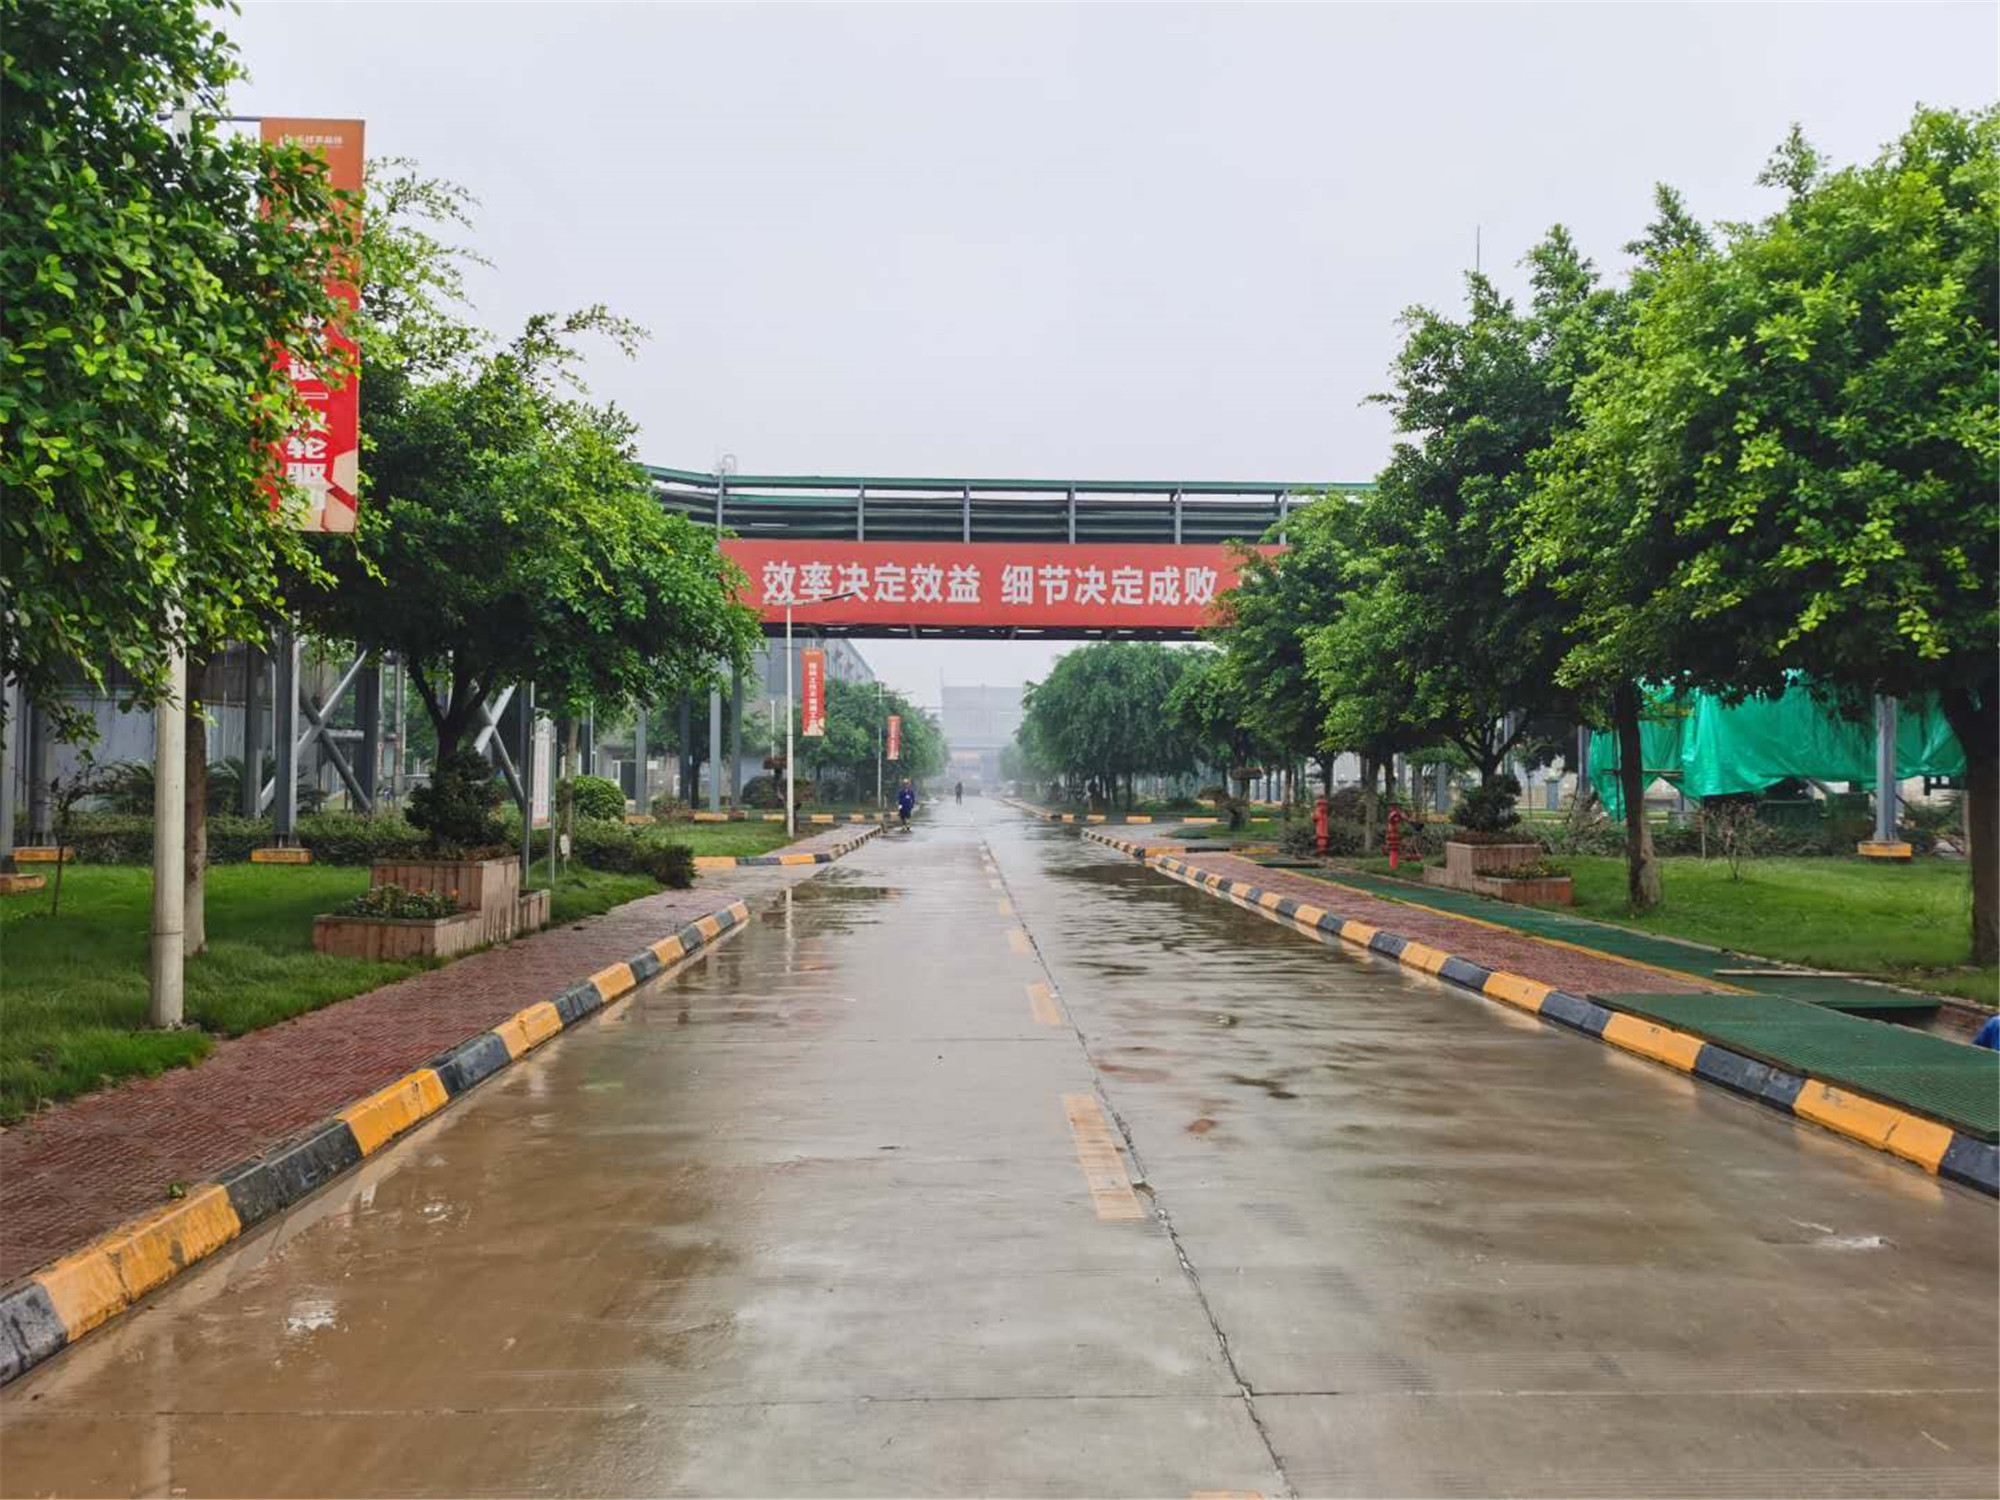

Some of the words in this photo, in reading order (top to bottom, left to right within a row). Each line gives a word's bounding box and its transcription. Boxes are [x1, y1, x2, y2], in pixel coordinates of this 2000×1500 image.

[762, 560, 981, 604] 效率决定效益
[1000, 563, 1218, 605] 细节决定成败
